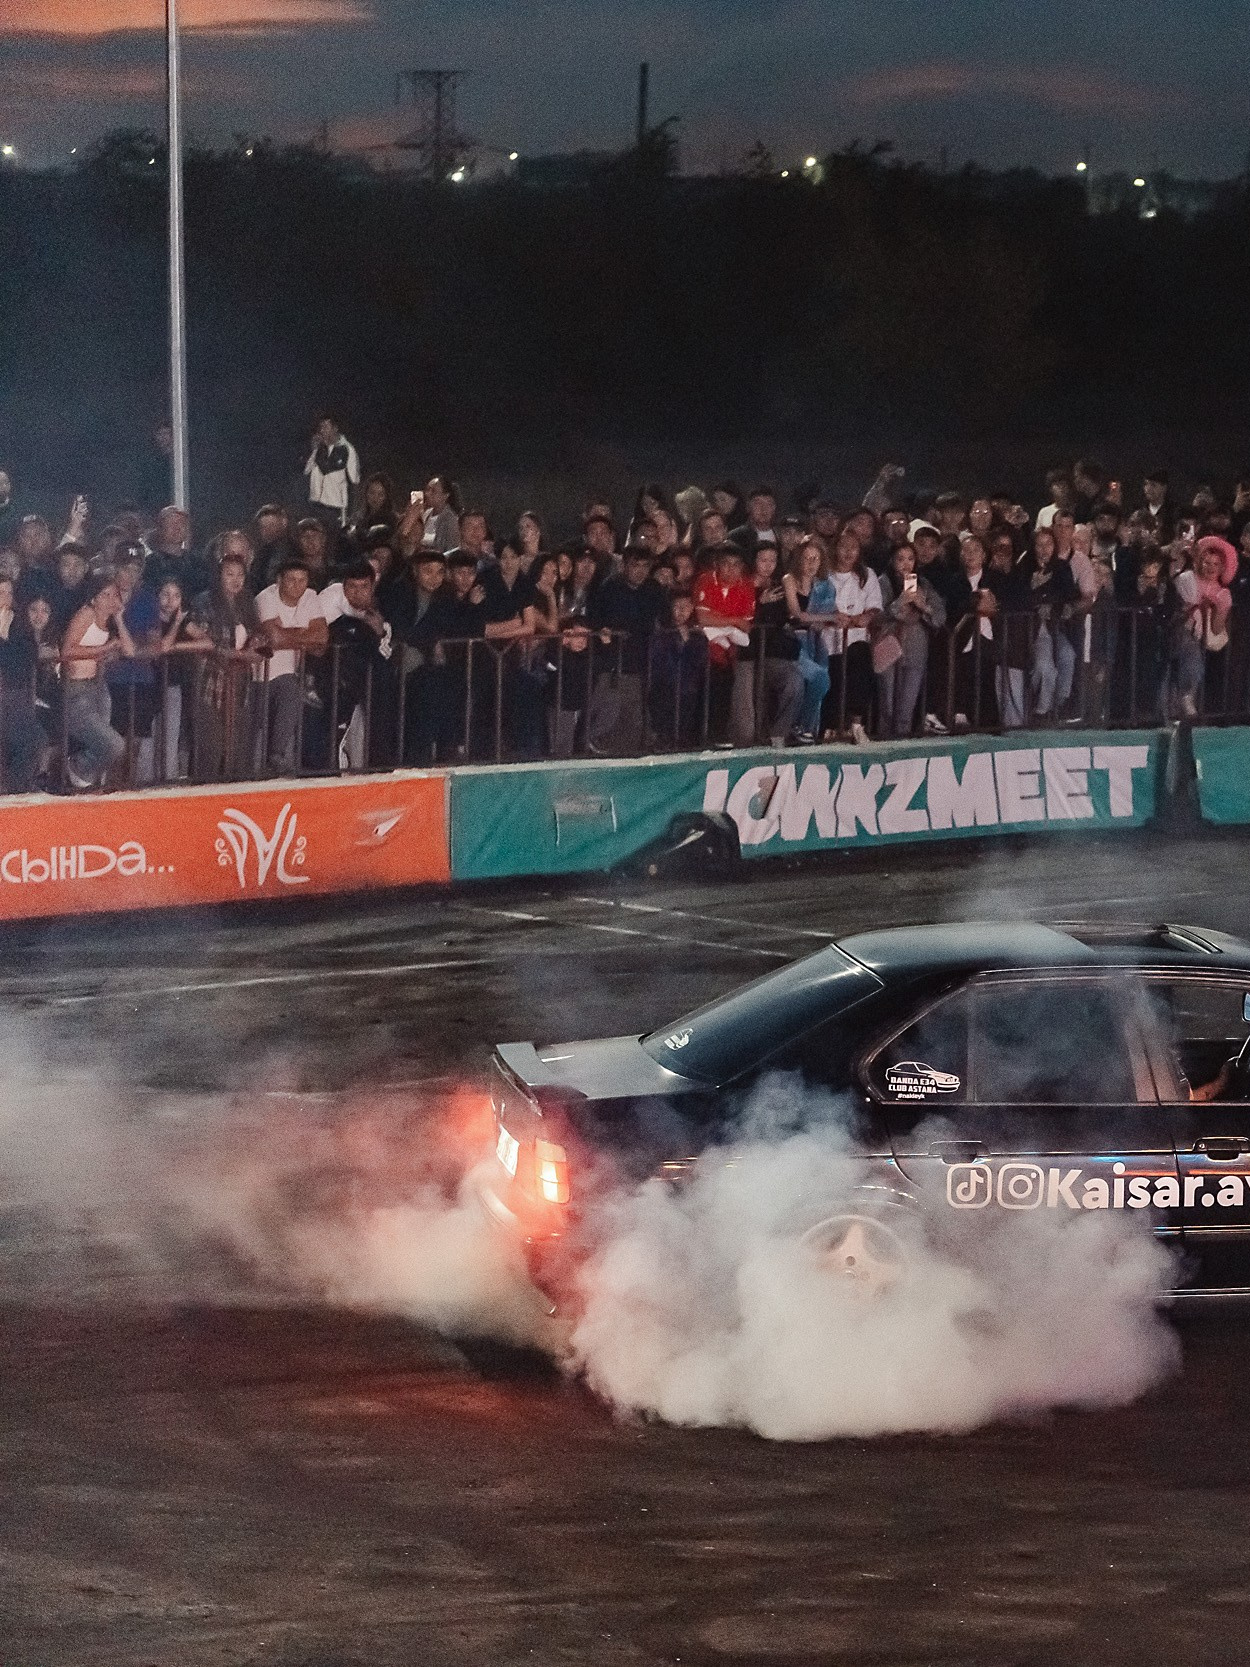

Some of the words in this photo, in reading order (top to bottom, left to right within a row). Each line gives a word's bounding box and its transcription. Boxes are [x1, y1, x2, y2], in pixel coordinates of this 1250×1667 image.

[920, 1078, 936, 1086] E34
[888, 1084, 907, 1092] CLUB
[908, 1085, 937, 1094] ASTANA
